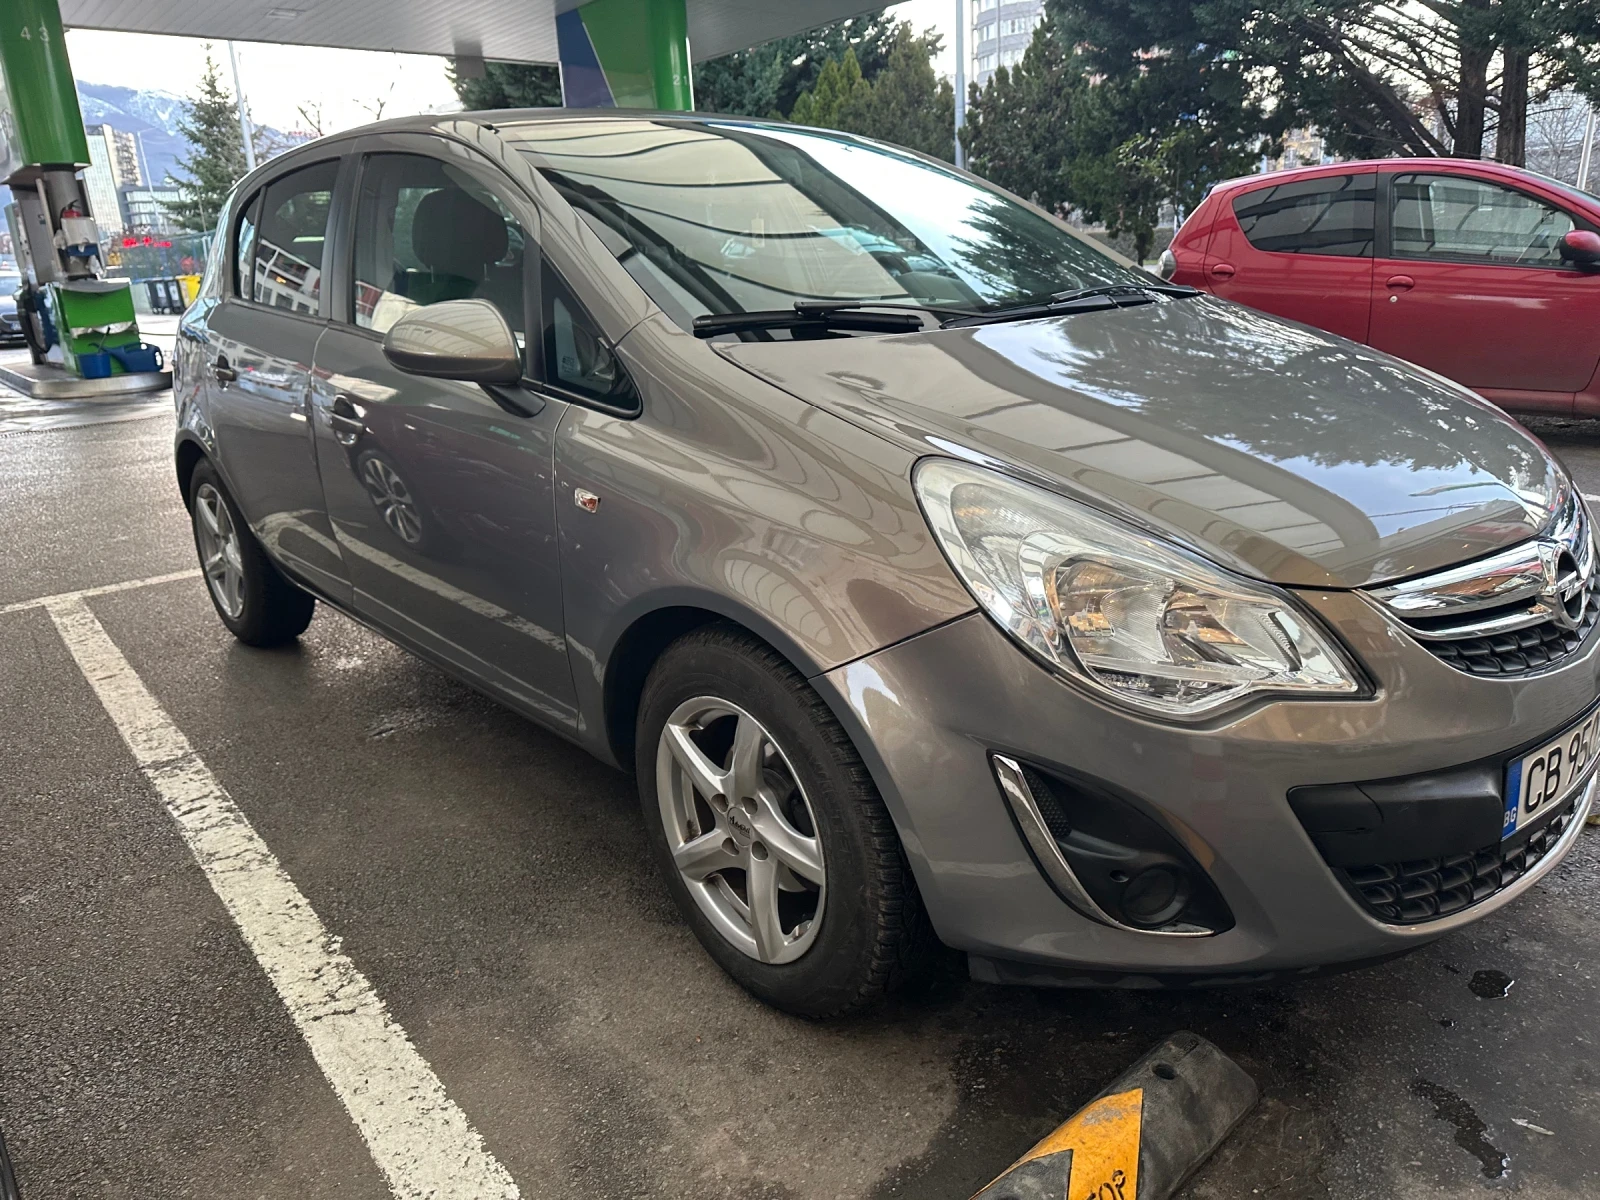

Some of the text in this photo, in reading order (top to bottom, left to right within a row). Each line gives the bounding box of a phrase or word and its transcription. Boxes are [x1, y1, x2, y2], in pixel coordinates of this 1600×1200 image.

[20, 26, 31, 41] 4
[672, 74, 681, 86] 2
[1525, 746, 1563, 814] CB
[1503, 806, 1517, 828] BG
